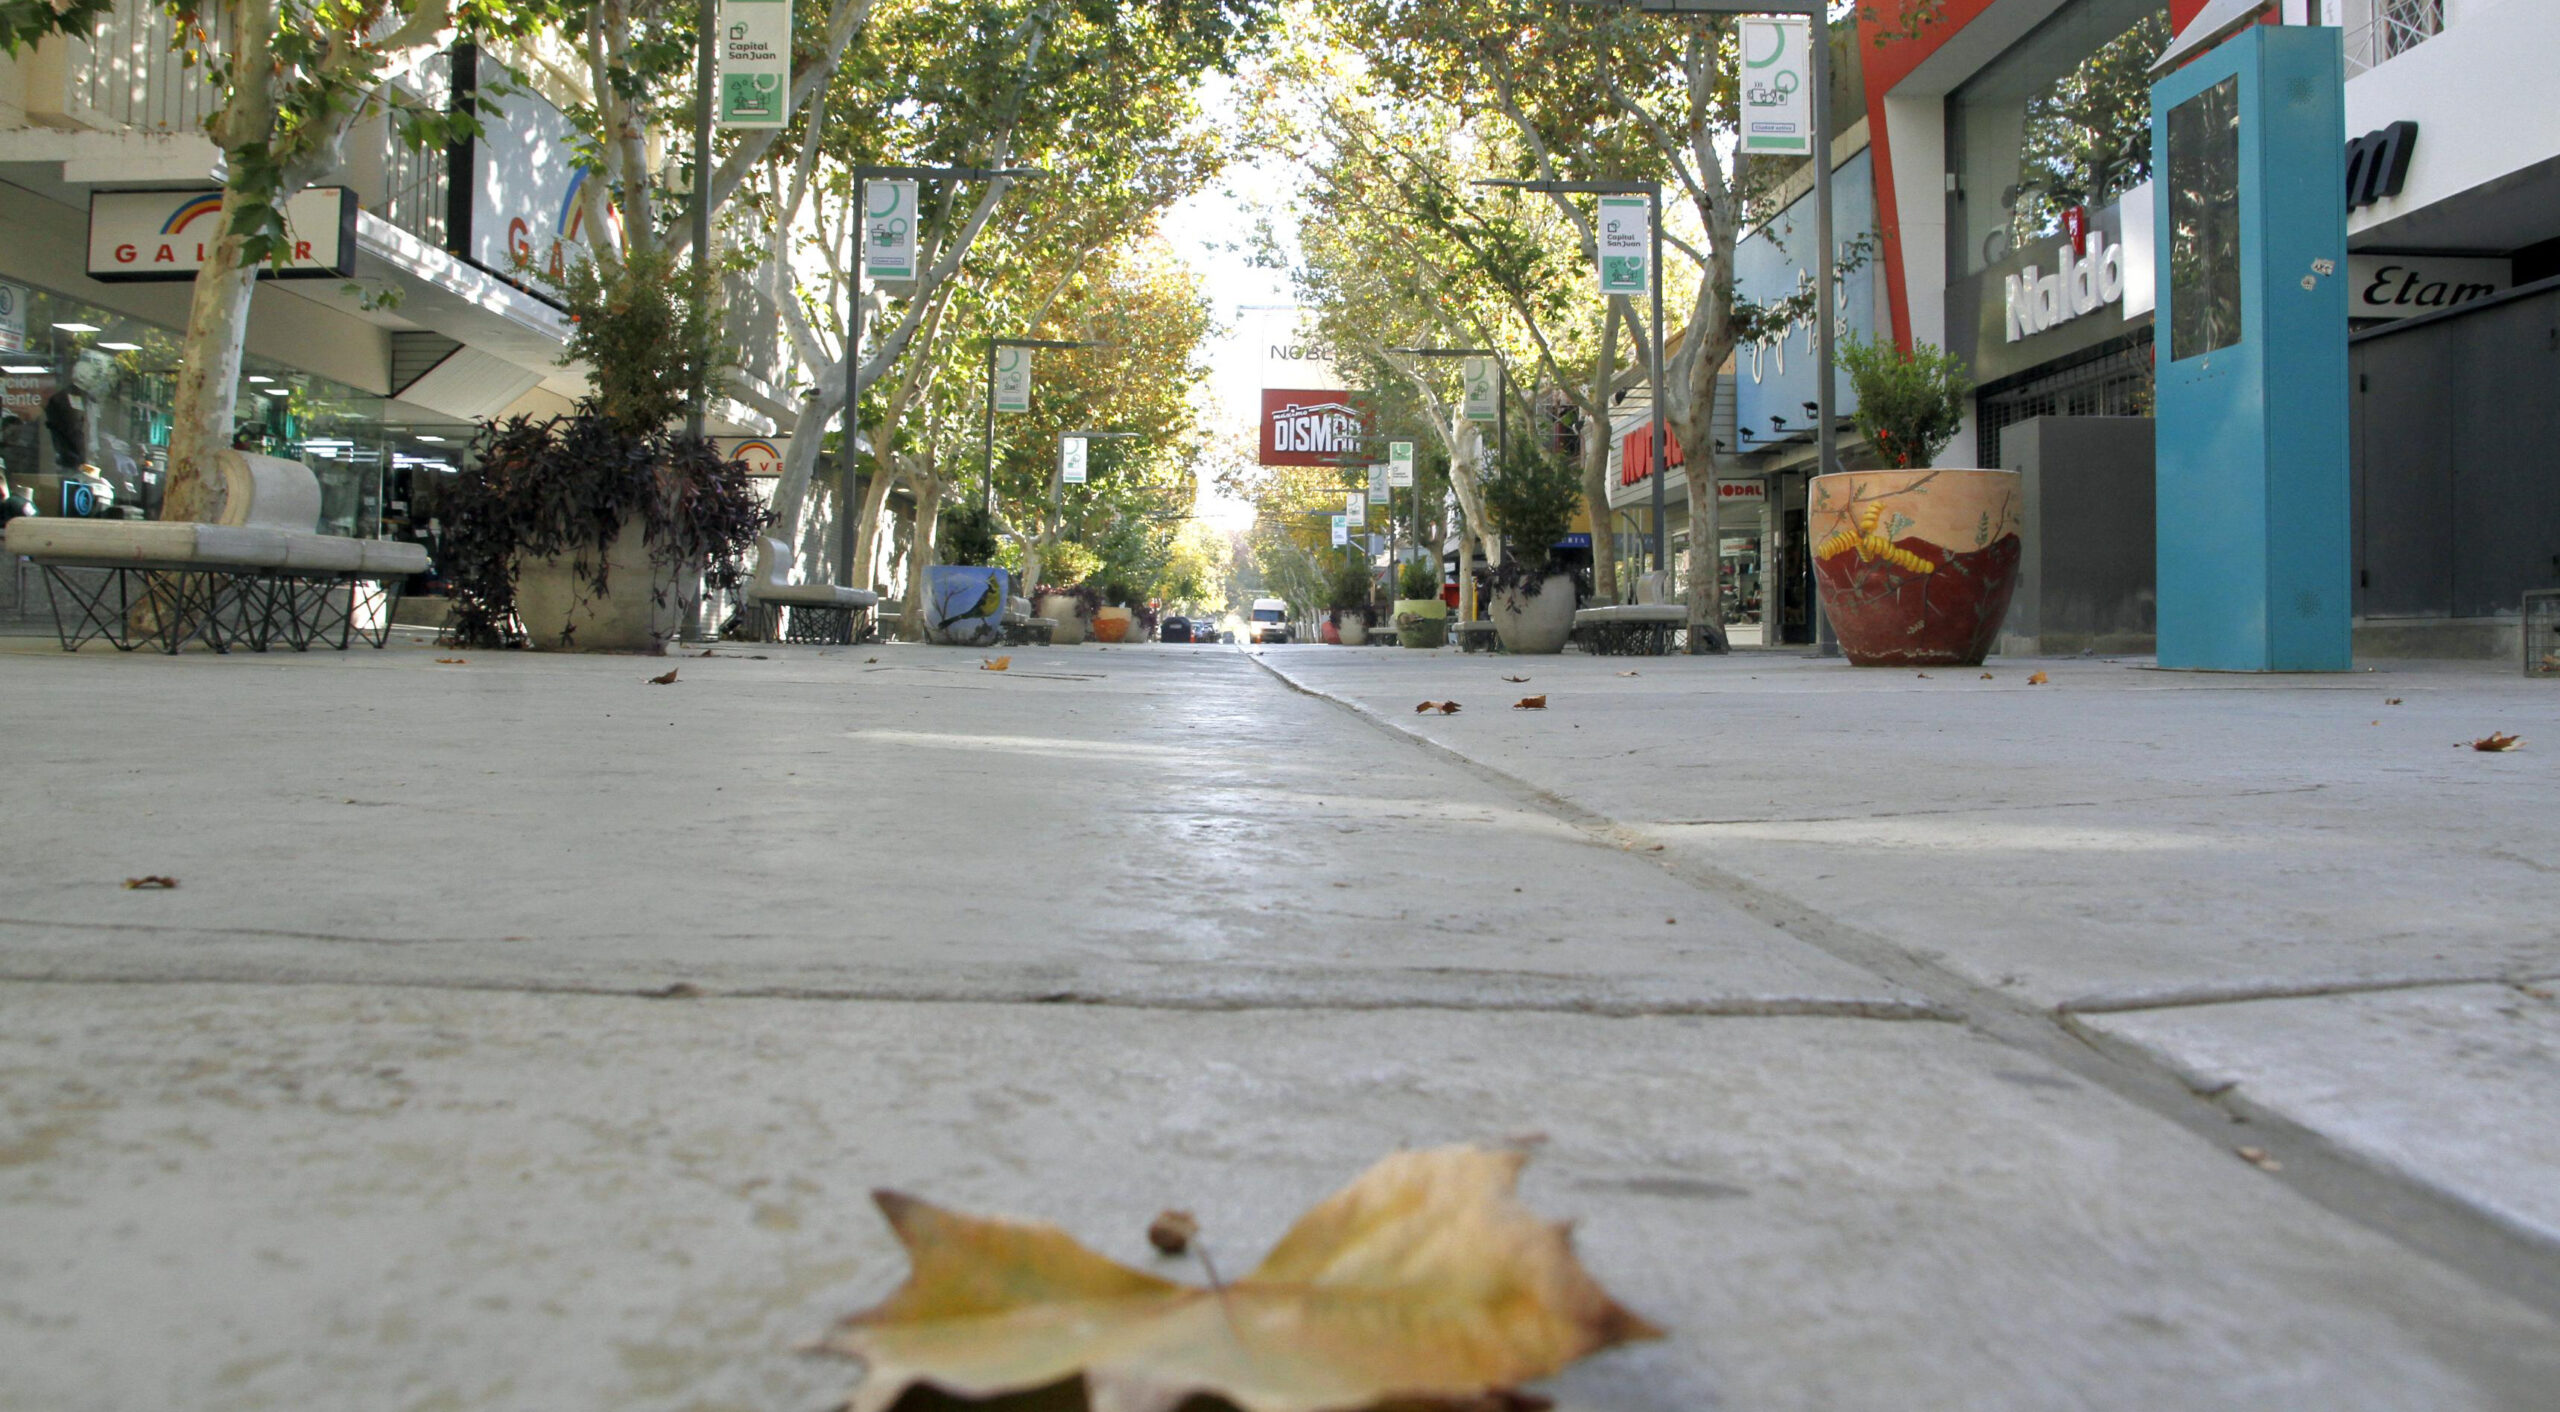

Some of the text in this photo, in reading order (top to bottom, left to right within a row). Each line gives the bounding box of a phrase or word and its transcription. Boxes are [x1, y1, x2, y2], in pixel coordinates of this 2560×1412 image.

[729, 42, 768, 52] Capital
[1607, 233, 1635, 242] Capital
[114, 240, 312, 264] GALR
[2005, 230, 2124, 343] Naldo
[2363, 265, 2495, 307] Etam
